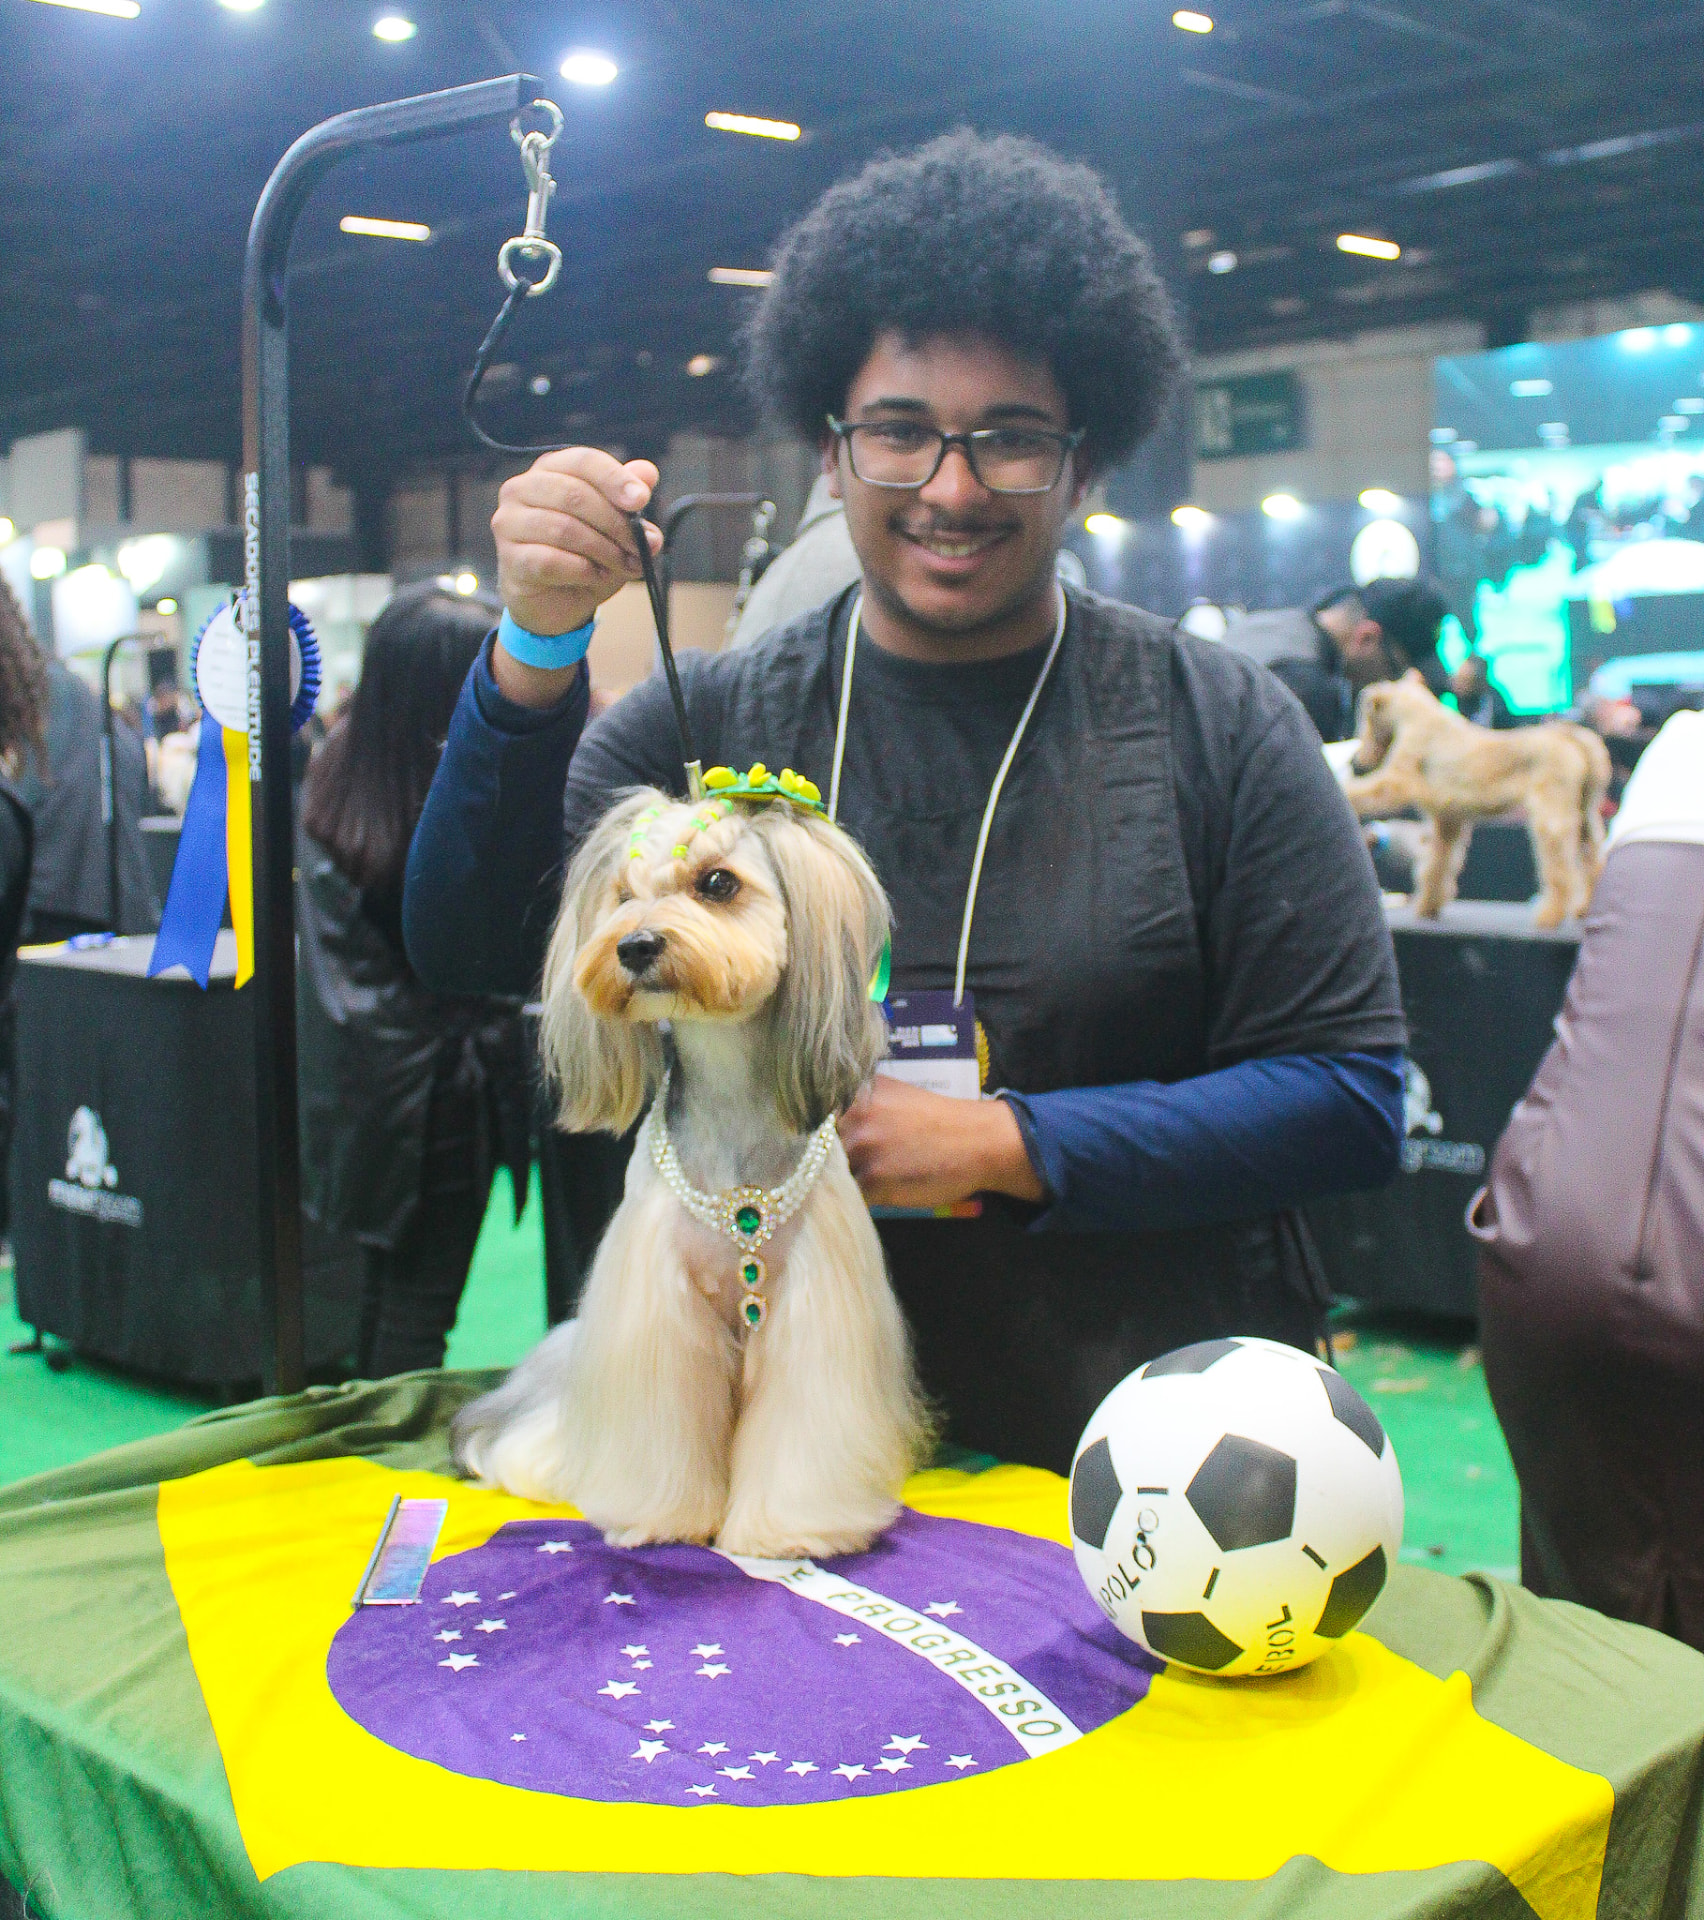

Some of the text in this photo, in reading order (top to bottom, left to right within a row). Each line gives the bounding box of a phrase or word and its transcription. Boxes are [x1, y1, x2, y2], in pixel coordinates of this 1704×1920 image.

[244, 471, 263, 782] SECADORES PLENITUDE
[827, 1592, 1063, 1737] PROGRESSO
